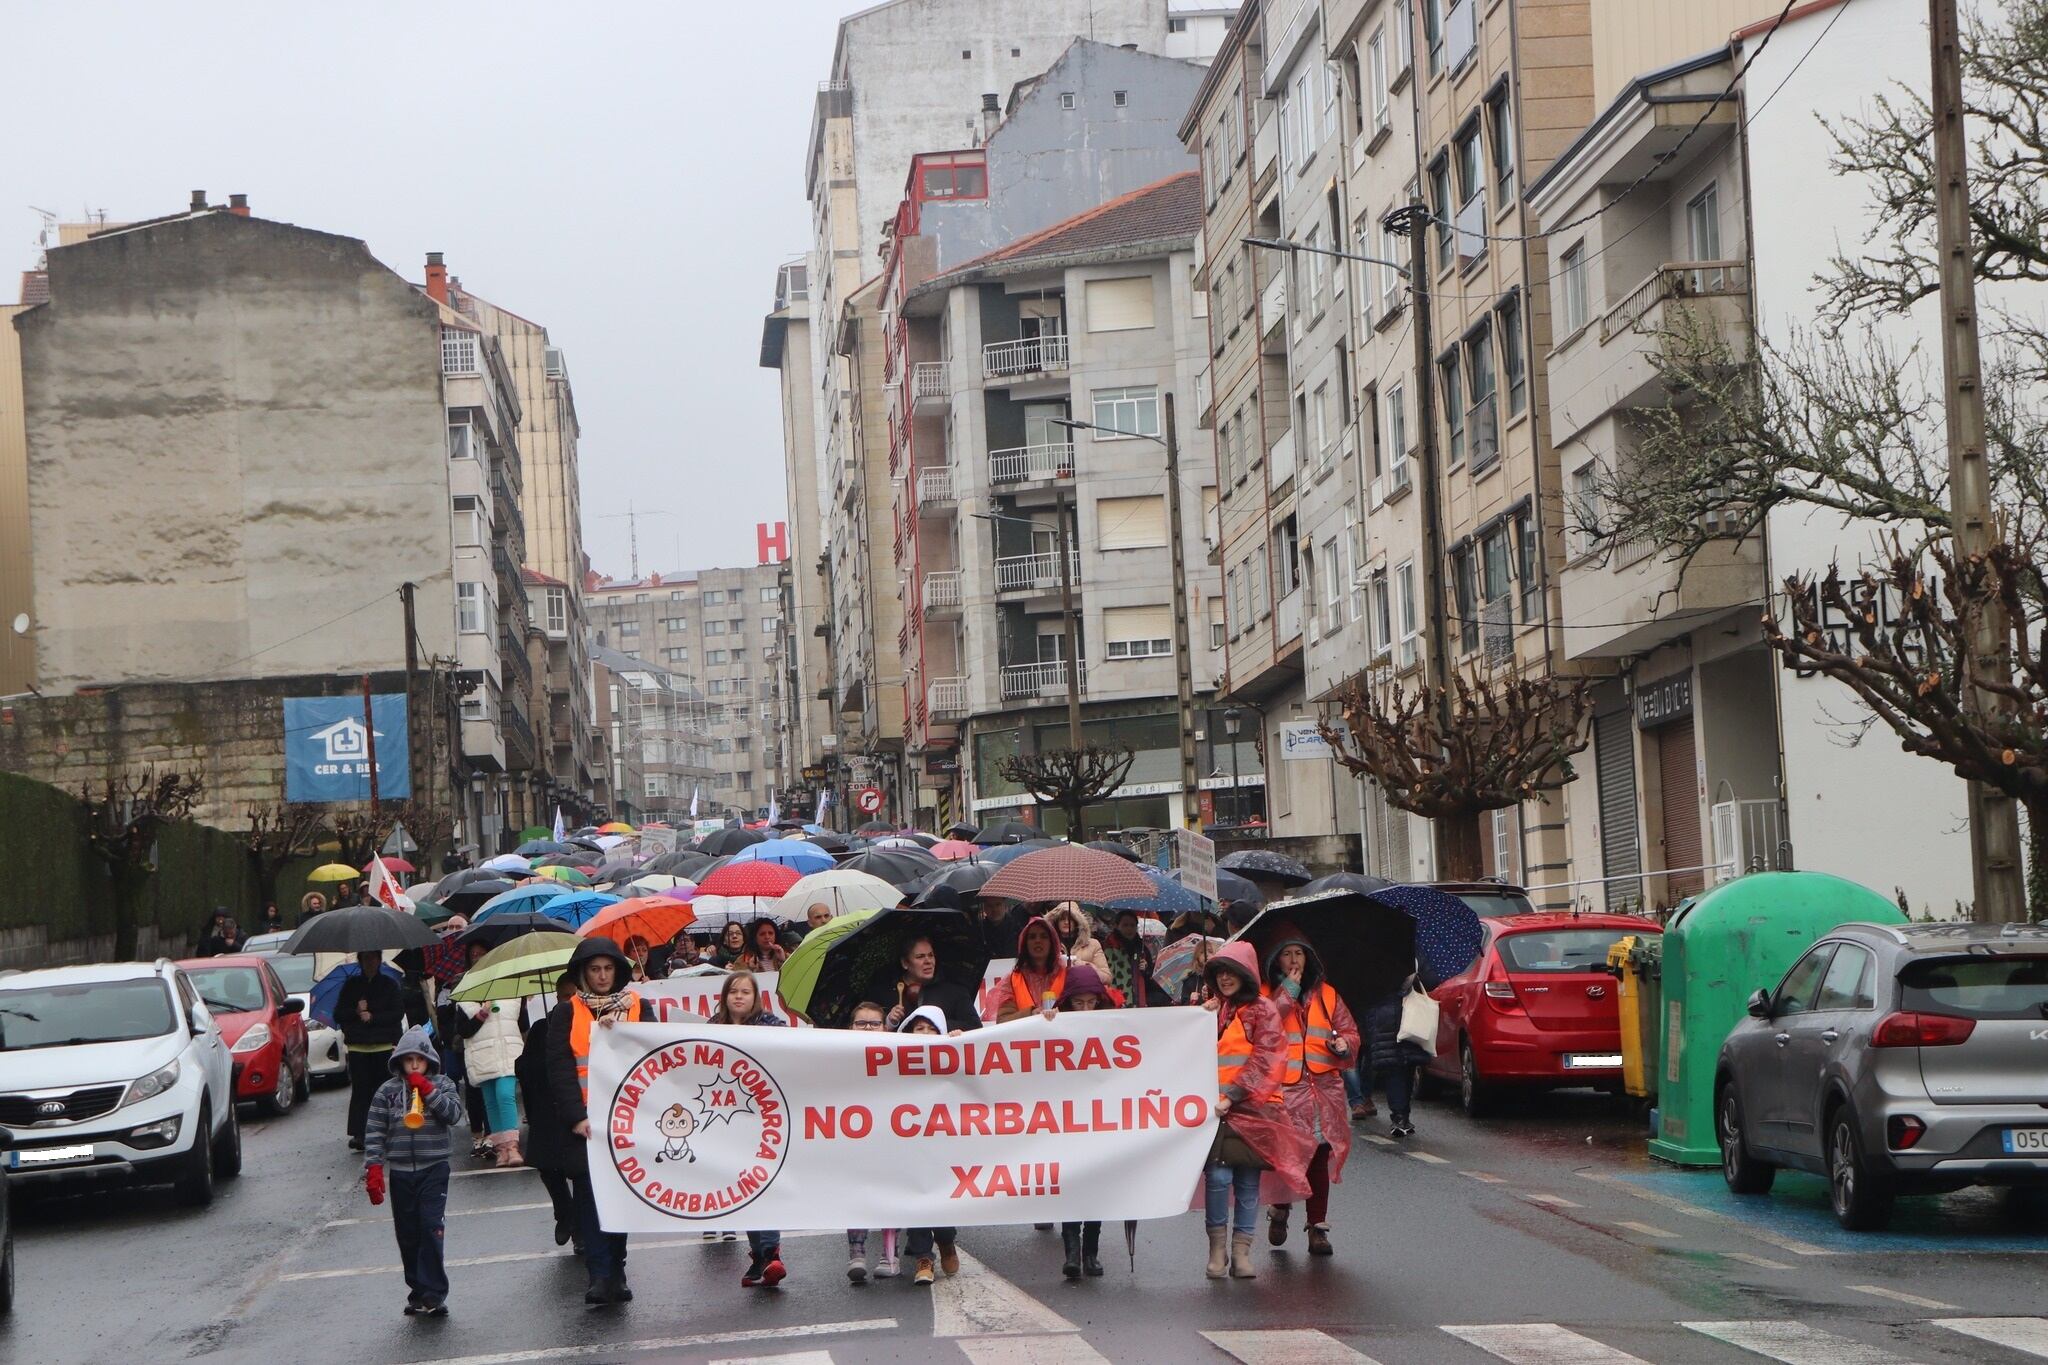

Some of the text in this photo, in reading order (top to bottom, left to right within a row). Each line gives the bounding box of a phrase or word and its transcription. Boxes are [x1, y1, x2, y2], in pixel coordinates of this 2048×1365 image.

[757, 522, 786, 562] H
[314, 764, 338, 775] CER
[342, 763, 353, 774] &
[864, 1035, 1142, 1077] PEDIATRAS
[41, 1103, 61, 1113] KIA
[613, 1044, 783, 1161] PEDIATRAS NA COMARCA
[711, 1090, 737, 1106] XA
[804, 1089, 1208, 1140] NO CARBALLIÑO
[618, 1156, 769, 1213] DO CARBALLIÑO
[952, 1162, 1060, 1199] XA!!!
